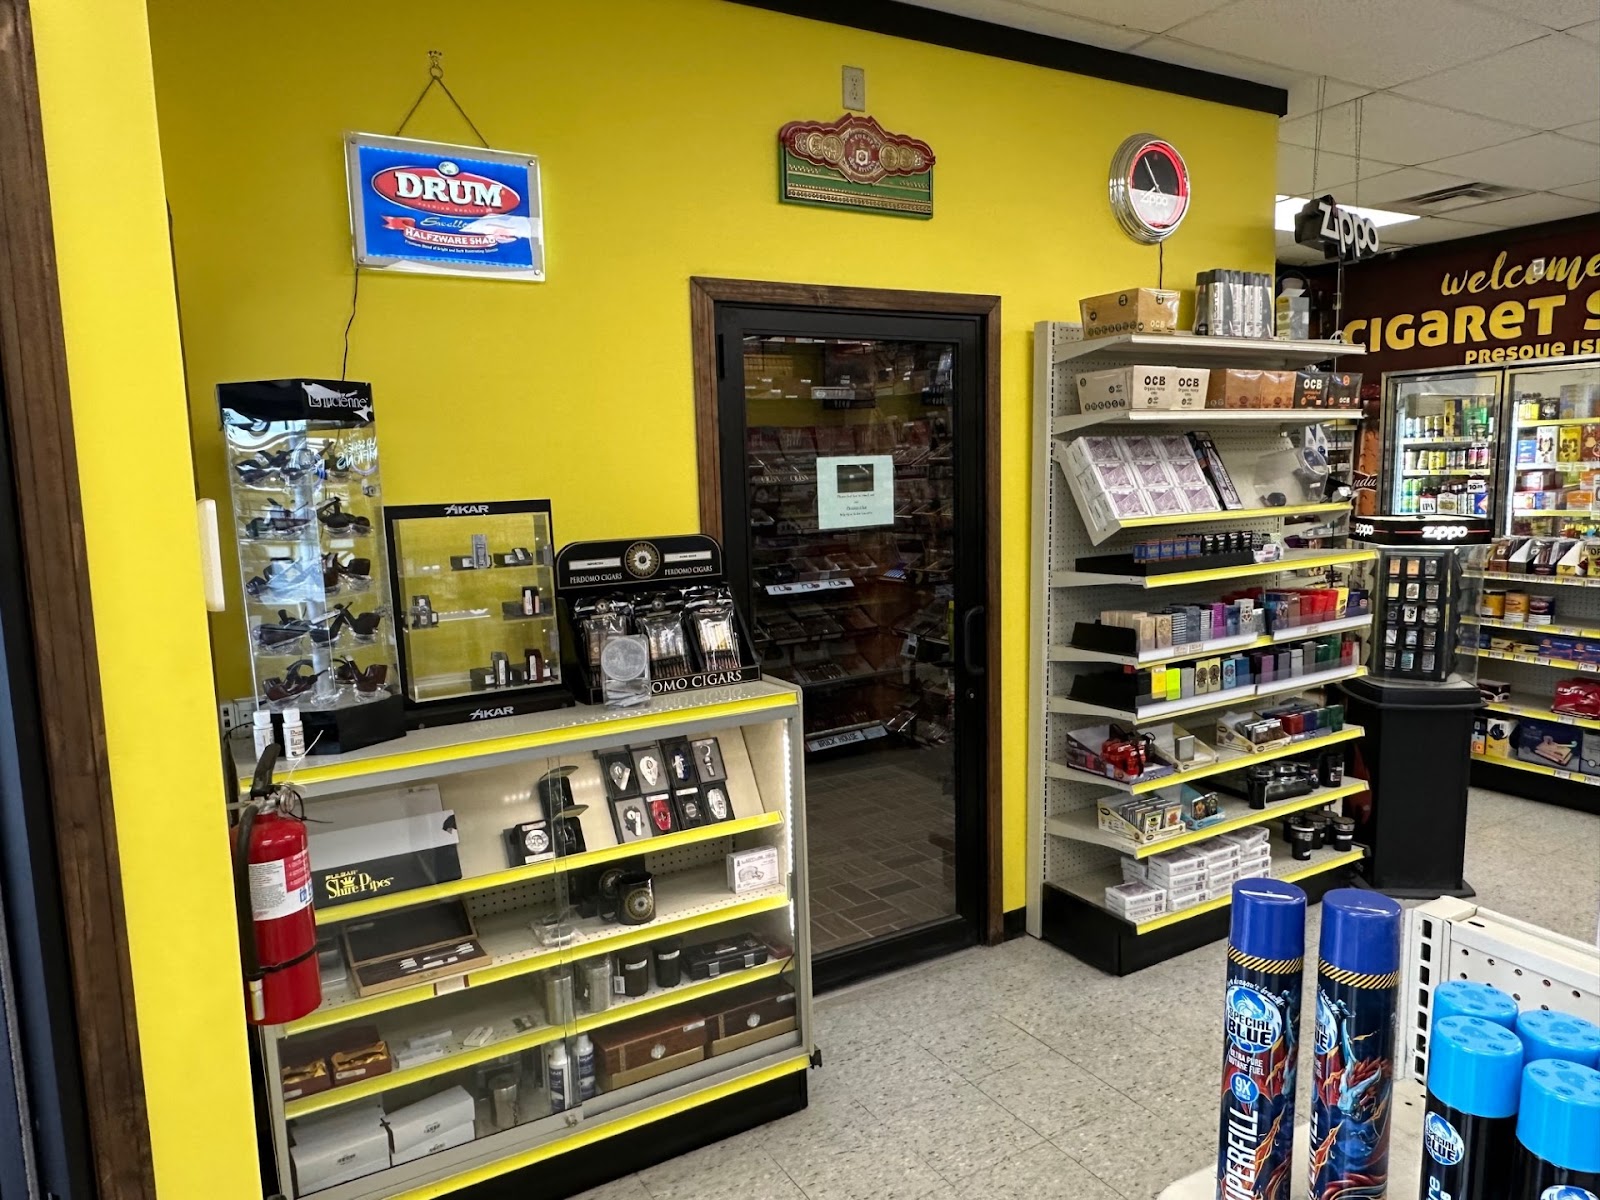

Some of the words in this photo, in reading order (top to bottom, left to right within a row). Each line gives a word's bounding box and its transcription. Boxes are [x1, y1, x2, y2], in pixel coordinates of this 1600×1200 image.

[394, 171, 503, 208] DRUM
[405, 227, 468, 245] HALFZWARE
[1441, 251, 1600, 296] welcome
[1150, 320, 1166, 329] OCB
[1144, 375, 1166, 386] OCB
[1178, 378, 1199, 388] OCB
[1303, 379, 1323, 390] OCB
[569, 574, 600, 585] PERDOMO
[601, 572, 623, 582] CIGARS
[664, 567, 692, 576] PERDOMO
[692, 565, 713, 574] CIGARS
[692, 670, 742, 688] CIGARS
[358, 872, 391, 893] Pipes
[1228, 1006, 1272, 1031] SPECIAL
[1228, 1018, 1272, 1046] BLUE
[1228, 1056, 1249, 1073] BUTANE
[1249, 1065, 1265, 1076] FUEL
[1229, 1049, 1246, 1062] ULTRA
[1245, 1057, 1264, 1067] PURE
[1235, 1076, 1251, 1095] 9X
[1426, 1136, 1457, 1163] BLUE
